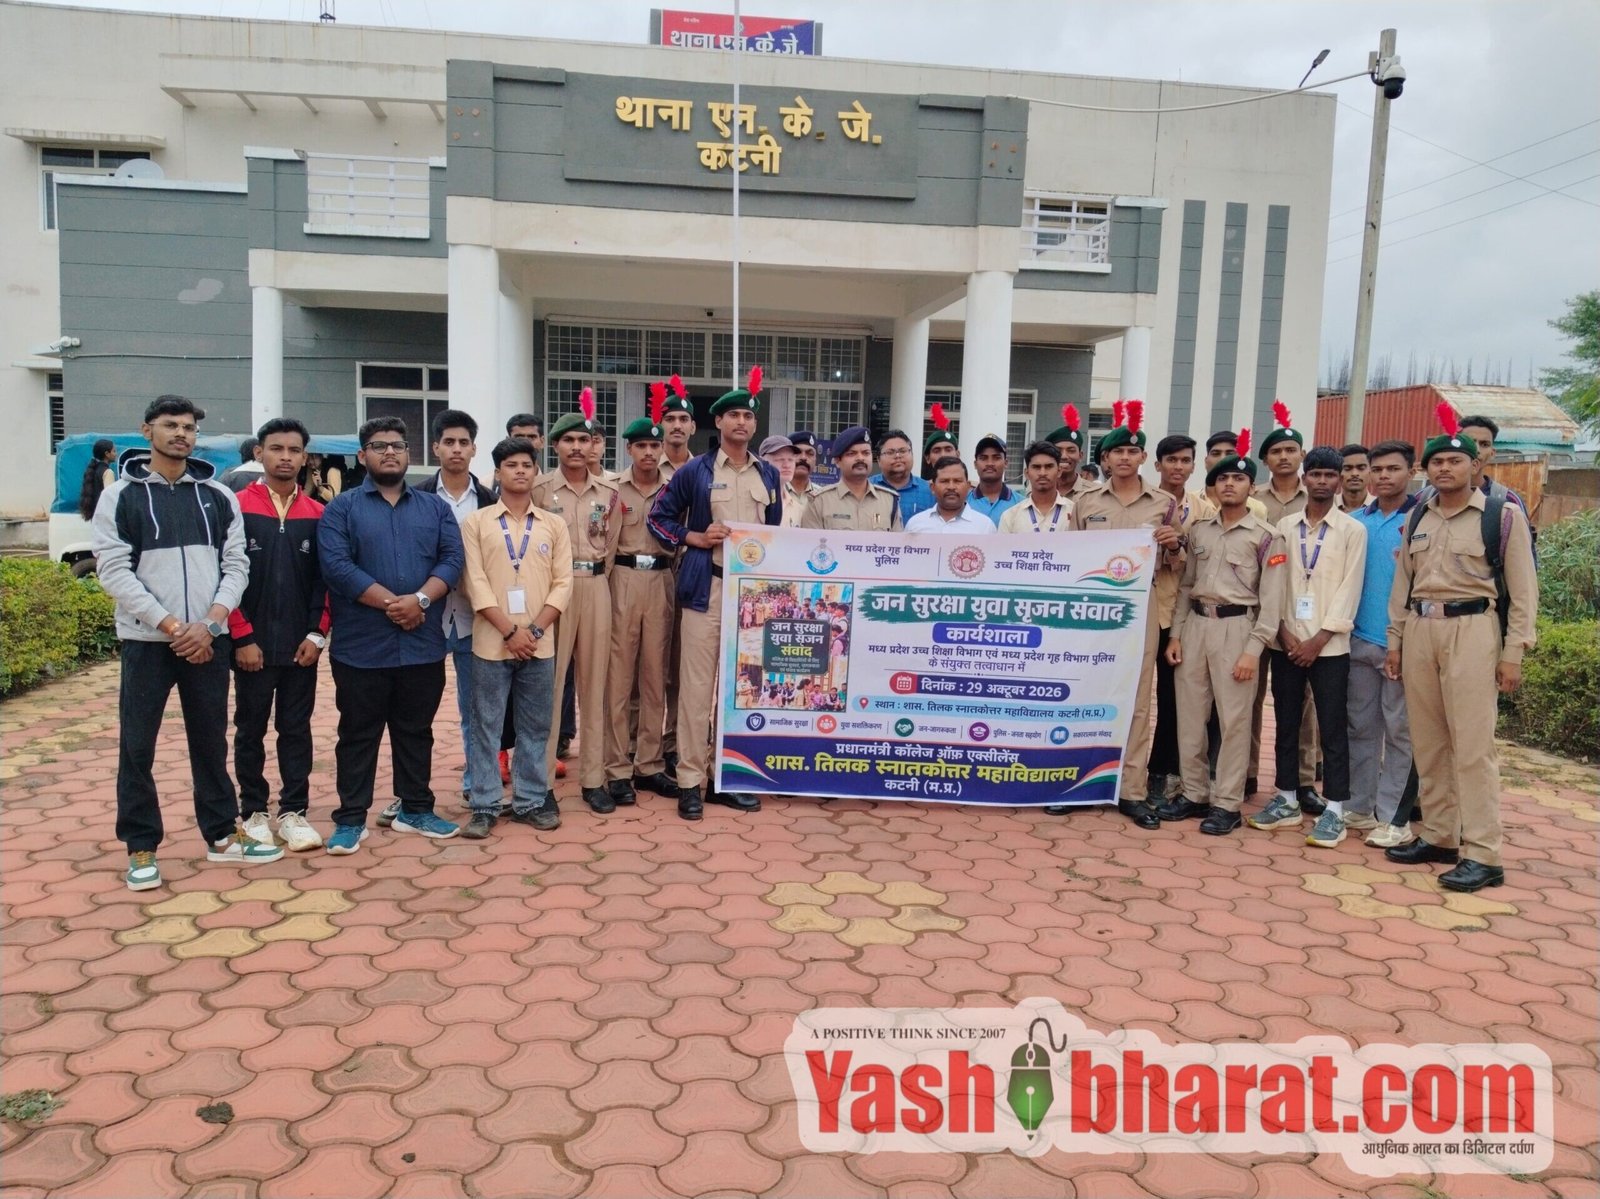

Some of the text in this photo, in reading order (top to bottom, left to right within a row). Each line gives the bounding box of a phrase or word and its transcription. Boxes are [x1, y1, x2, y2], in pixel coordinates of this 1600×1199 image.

[670, 30, 716, 49] थाना
[615, 95, 882, 144] थाना एन. के. जे.
[696, 133, 782, 175] कटनी
[845, 544, 930, 556] मध्य प्रदेश गृह विभाग
[1011, 549, 1054, 560] मध्य प्रदेश
[875, 556, 899, 567] पुलिस
[994, 560, 1071, 572] उच्च शिक्षा विभाग
[871, 593, 1125, 623] जन सुरक्षा युवा सृजन संवाद
[771, 622, 824, 634] जन सुरक्षा
[946, 624, 1029, 644] कार्यशाला
[770, 633, 792, 645] युवा
[781, 644, 813, 657] संवाद
[868, 643, 1116, 665] मध्य प्रदेश उच्च शिक्षा विभाग एवं मध्य प्रदेश गृह विभाग पुलिस
[928, 656, 938, 668] के
[941, 657, 971, 671] संयुक्त
[1017, 661, 1025, 672] में
[921, 677, 957, 692] दिनांक
[966, 682, 983, 694] 29
[986, 684, 1026, 698] अक्टूबर
[1028, 685, 1062, 697] 2026
[875, 700, 895, 709] स्थान
[903, 702, 924, 711] शास.
[927, 701, 953, 712] तिलक
[956, 704, 1002, 715] स्नातकोत्तर
[1004, 706, 1054, 718] महाविद्यालय
[1058, 707, 1080, 718] कटनी
[1081, 708, 1106, 719] (म.प्र.)
[993, 728, 1007, 738] पुलिस
[835, 742, 891, 756] प्रधानमंत्री
[894, 743, 934, 758] कॉलेज
[967, 748, 1019, 763] एक्सीलेंस
[765, 752, 1080, 784] शास. तिलक स्नातकोत्तर महाविद्यालय
[884, 778, 962, 796] कटनी (म.प्र.)
